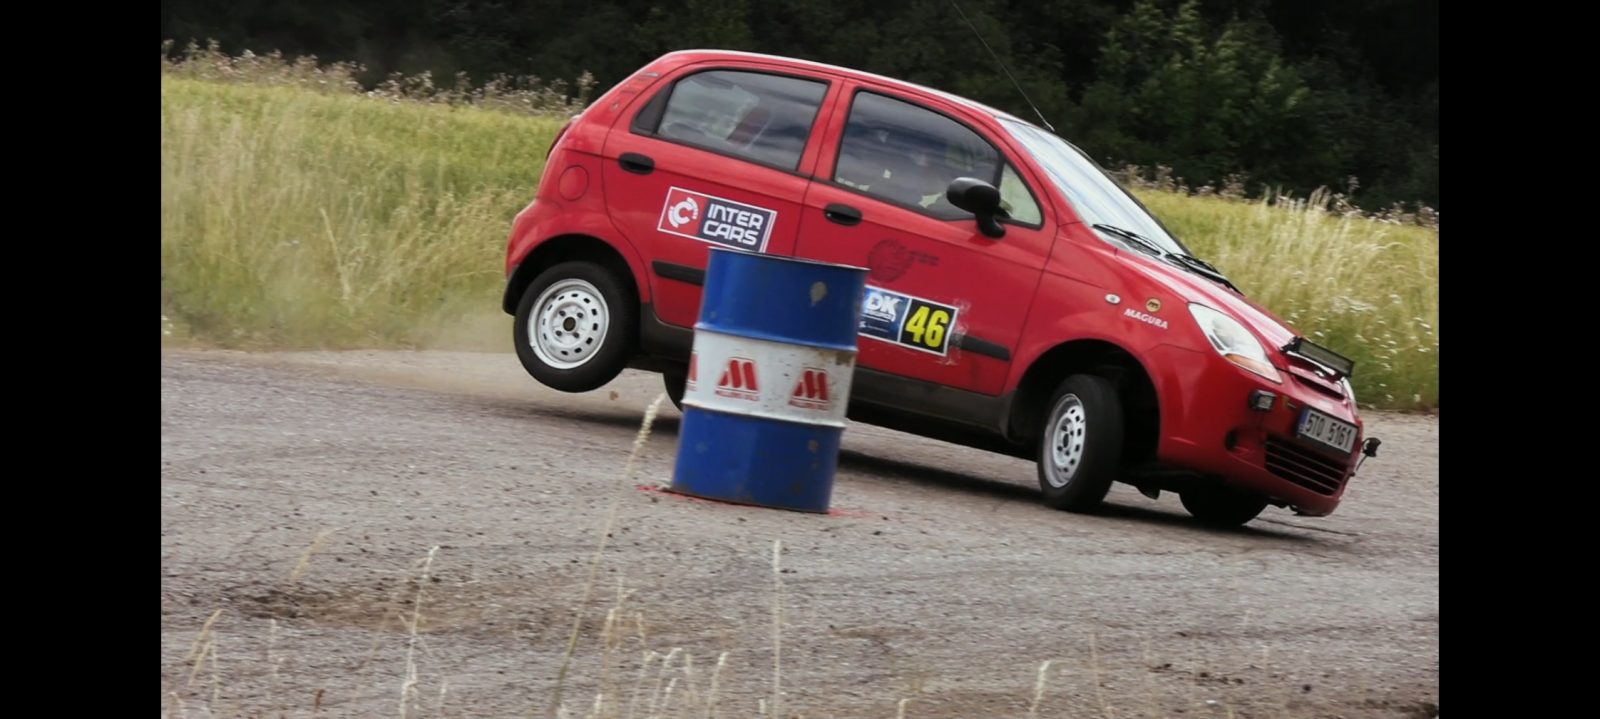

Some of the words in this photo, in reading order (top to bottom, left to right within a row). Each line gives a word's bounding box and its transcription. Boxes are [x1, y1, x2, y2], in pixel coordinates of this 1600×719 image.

[707, 203, 764, 230] INTER
[702, 220, 759, 246] CARS
[905, 305, 950, 348] 46
[1123, 308, 1169, 330] MAGURA
